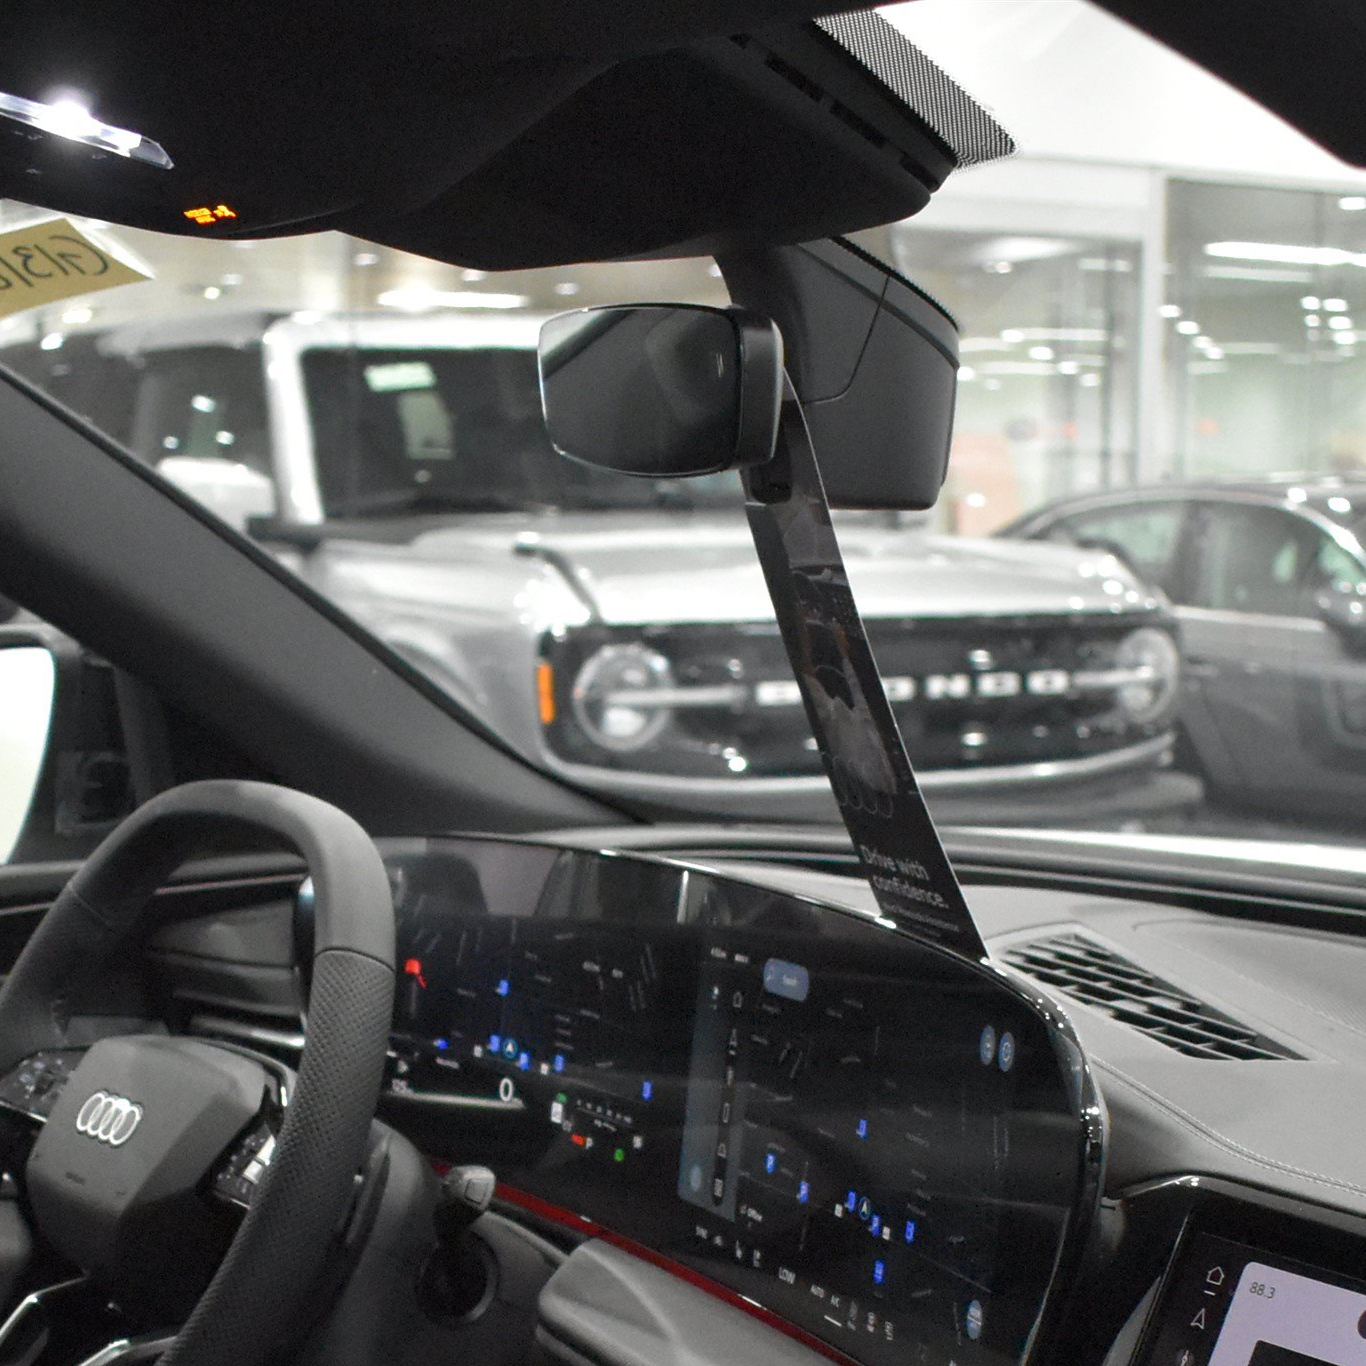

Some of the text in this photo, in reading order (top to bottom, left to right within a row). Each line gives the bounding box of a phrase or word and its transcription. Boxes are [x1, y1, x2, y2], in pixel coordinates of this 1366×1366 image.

[860, 845, 930, 881] Drive with
[872, 875, 950, 909] confidence.
[778, 1265, 796, 1285] LOW
[1249, 1281, 1276, 1300] 88.3
